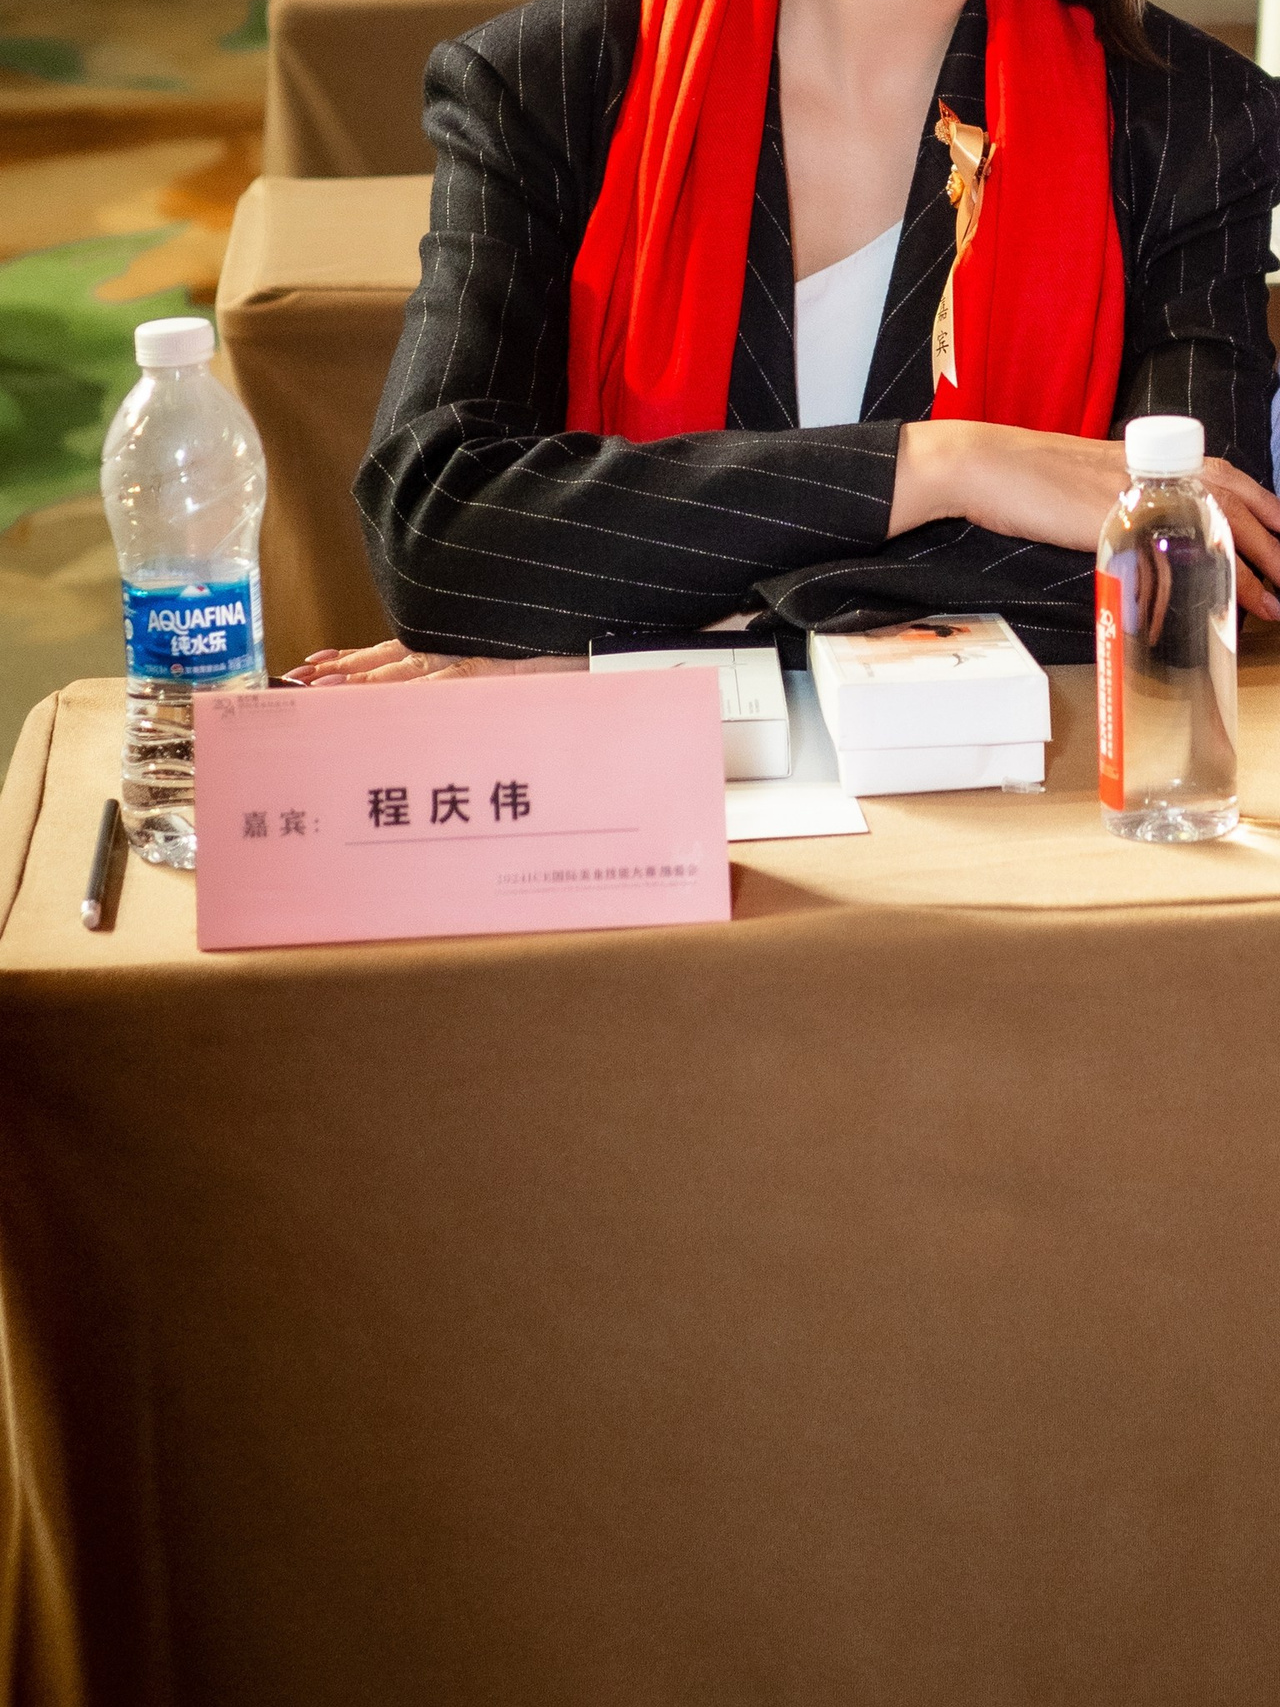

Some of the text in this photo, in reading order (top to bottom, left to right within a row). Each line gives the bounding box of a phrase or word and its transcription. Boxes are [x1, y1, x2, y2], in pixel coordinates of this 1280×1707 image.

[147, 601, 246, 635] AQUAFINA
[170, 630, 227, 656] 纯水乐
[367, 780, 532, 829] 程庆伟
[242, 808, 321, 839] 嘉宾:
